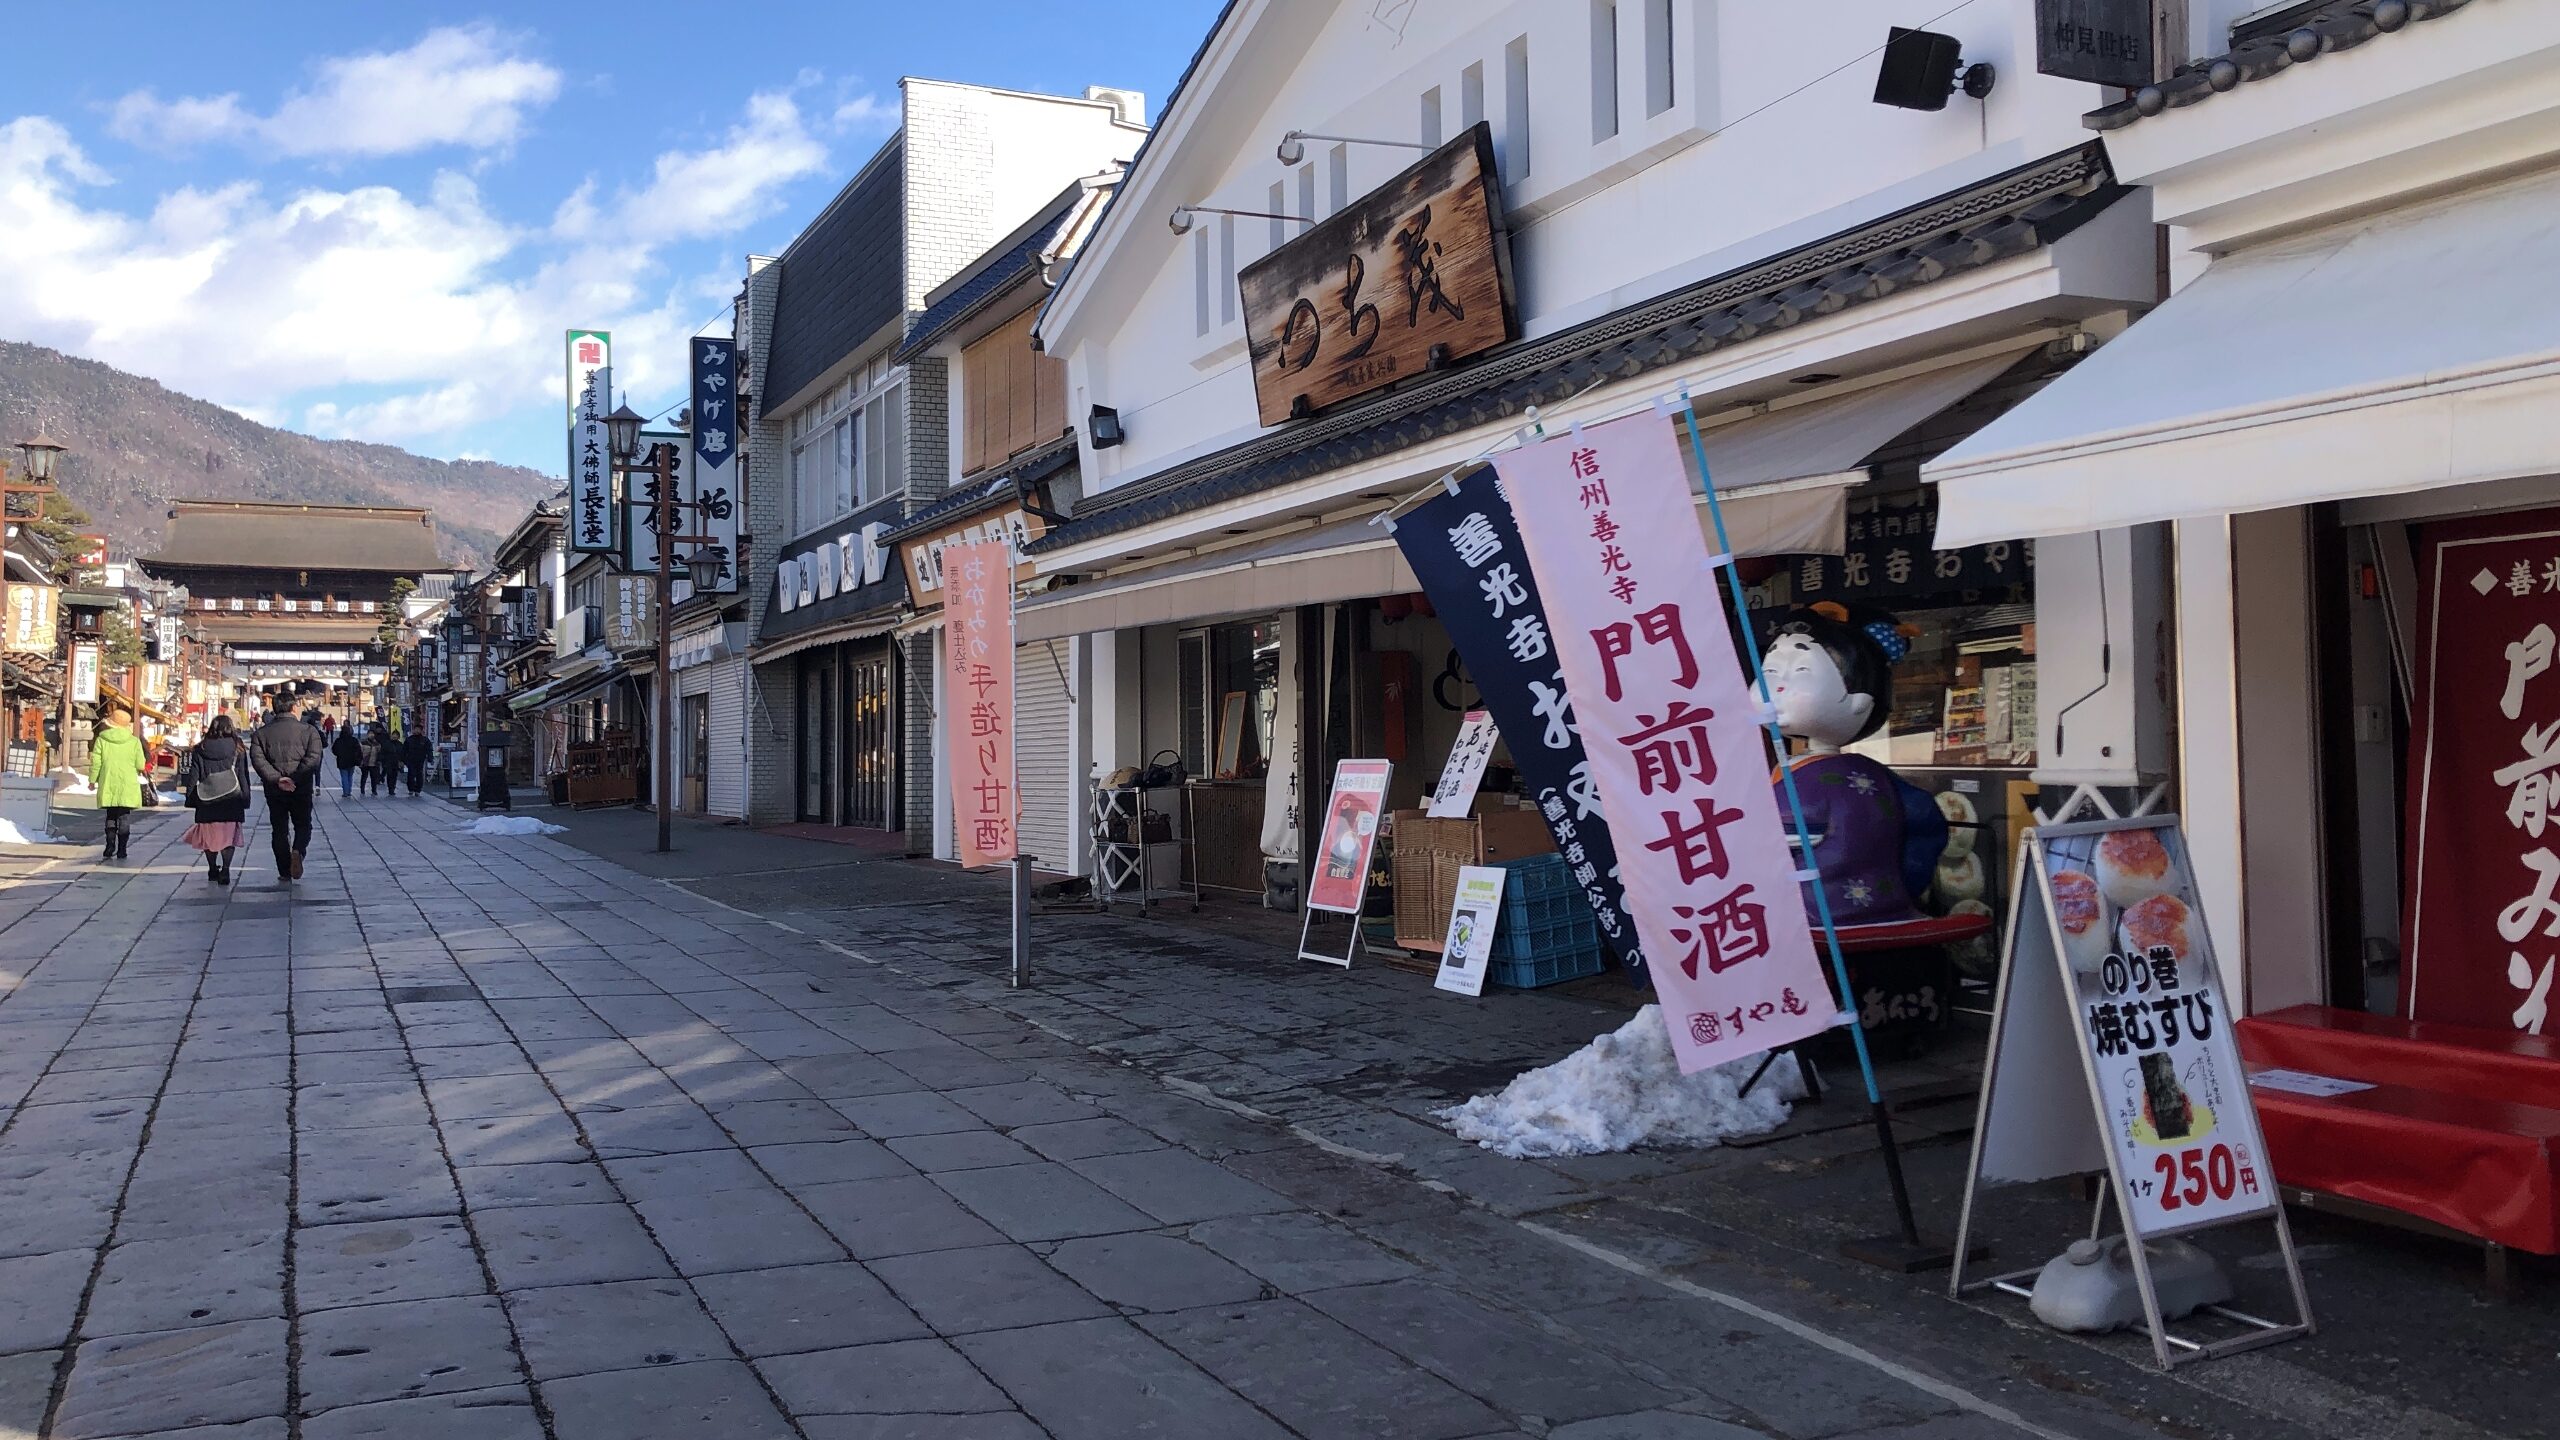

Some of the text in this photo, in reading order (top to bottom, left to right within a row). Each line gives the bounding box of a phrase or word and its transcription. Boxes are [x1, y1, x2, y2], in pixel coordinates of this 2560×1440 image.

[583, 369, 600, 436] 善光寺御用
[702, 344, 728, 453] みやげ店
[579, 486, 606, 545] 長生堂
[1568, 446, 1638, 606] 信州善光寺
[1588, 602, 1773, 983] 門前甘酒
[2101, 944, 2181, 998] のり巻
[1724, 986, 1810, 1038] すや亀
[2089, 986, 2215, 1059] 焼むすび
[2154, 1143, 2237, 1212] 250
[2239, 1167, 2260, 1196] 円
